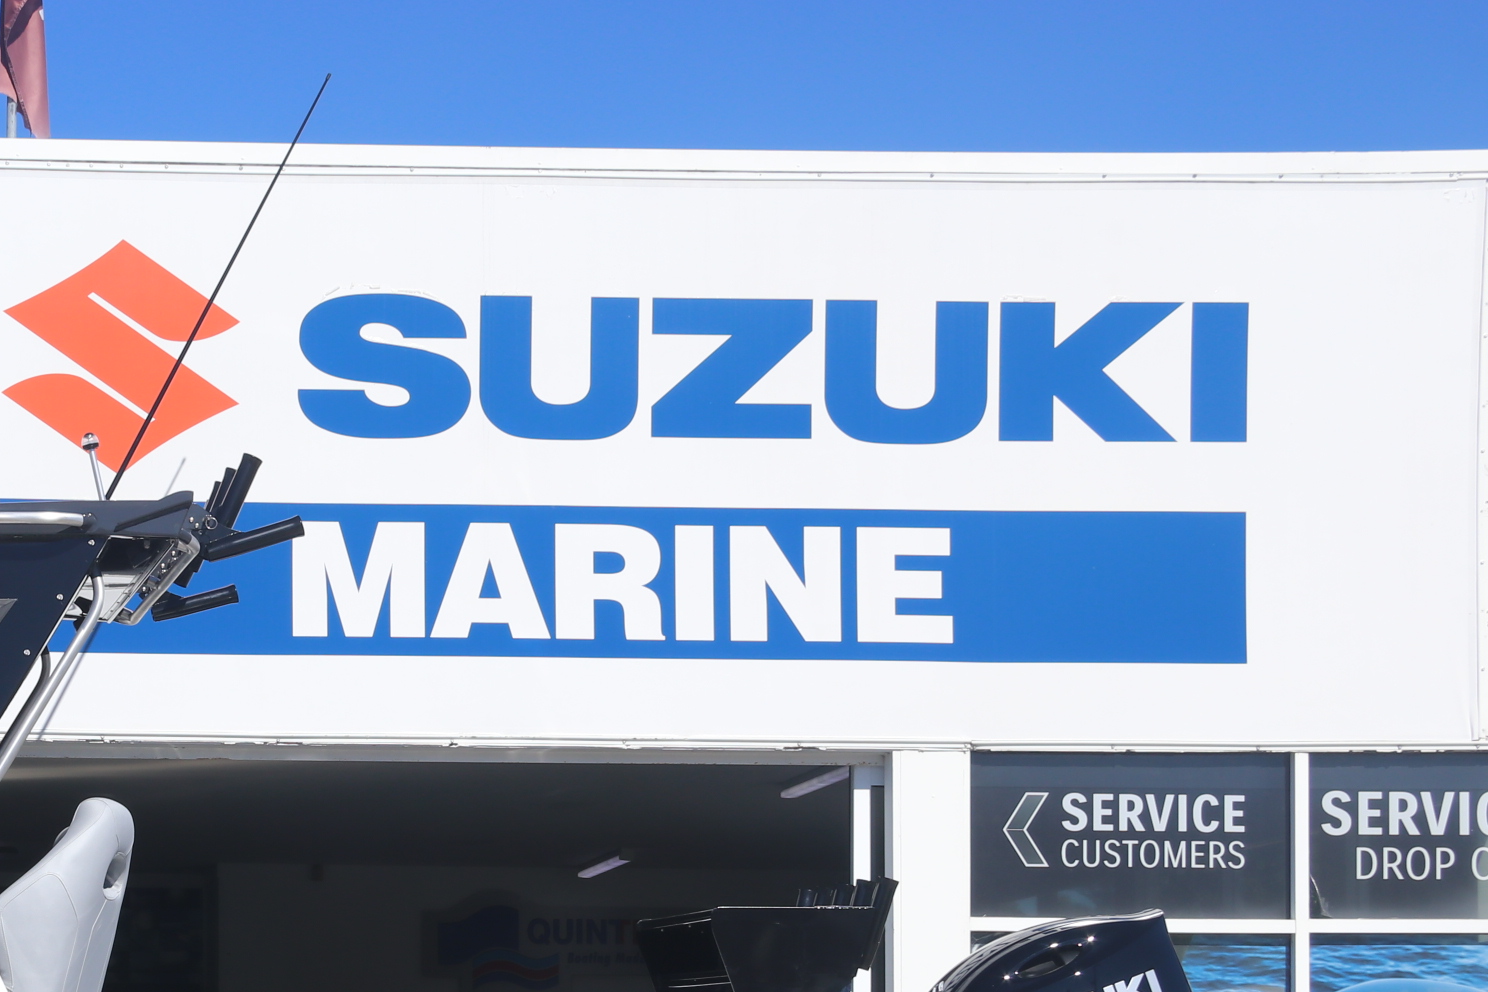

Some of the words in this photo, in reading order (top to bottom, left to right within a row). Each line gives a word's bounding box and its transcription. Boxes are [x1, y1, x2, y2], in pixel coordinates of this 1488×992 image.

[297, 294, 1250, 444] SUZUKI
[291, 520, 955, 645] MARINE
[1061, 792, 1246, 833] SERVICE
[1060, 838, 1246, 869] CUSTOMERS
[1356, 846, 1456, 880] DROP
